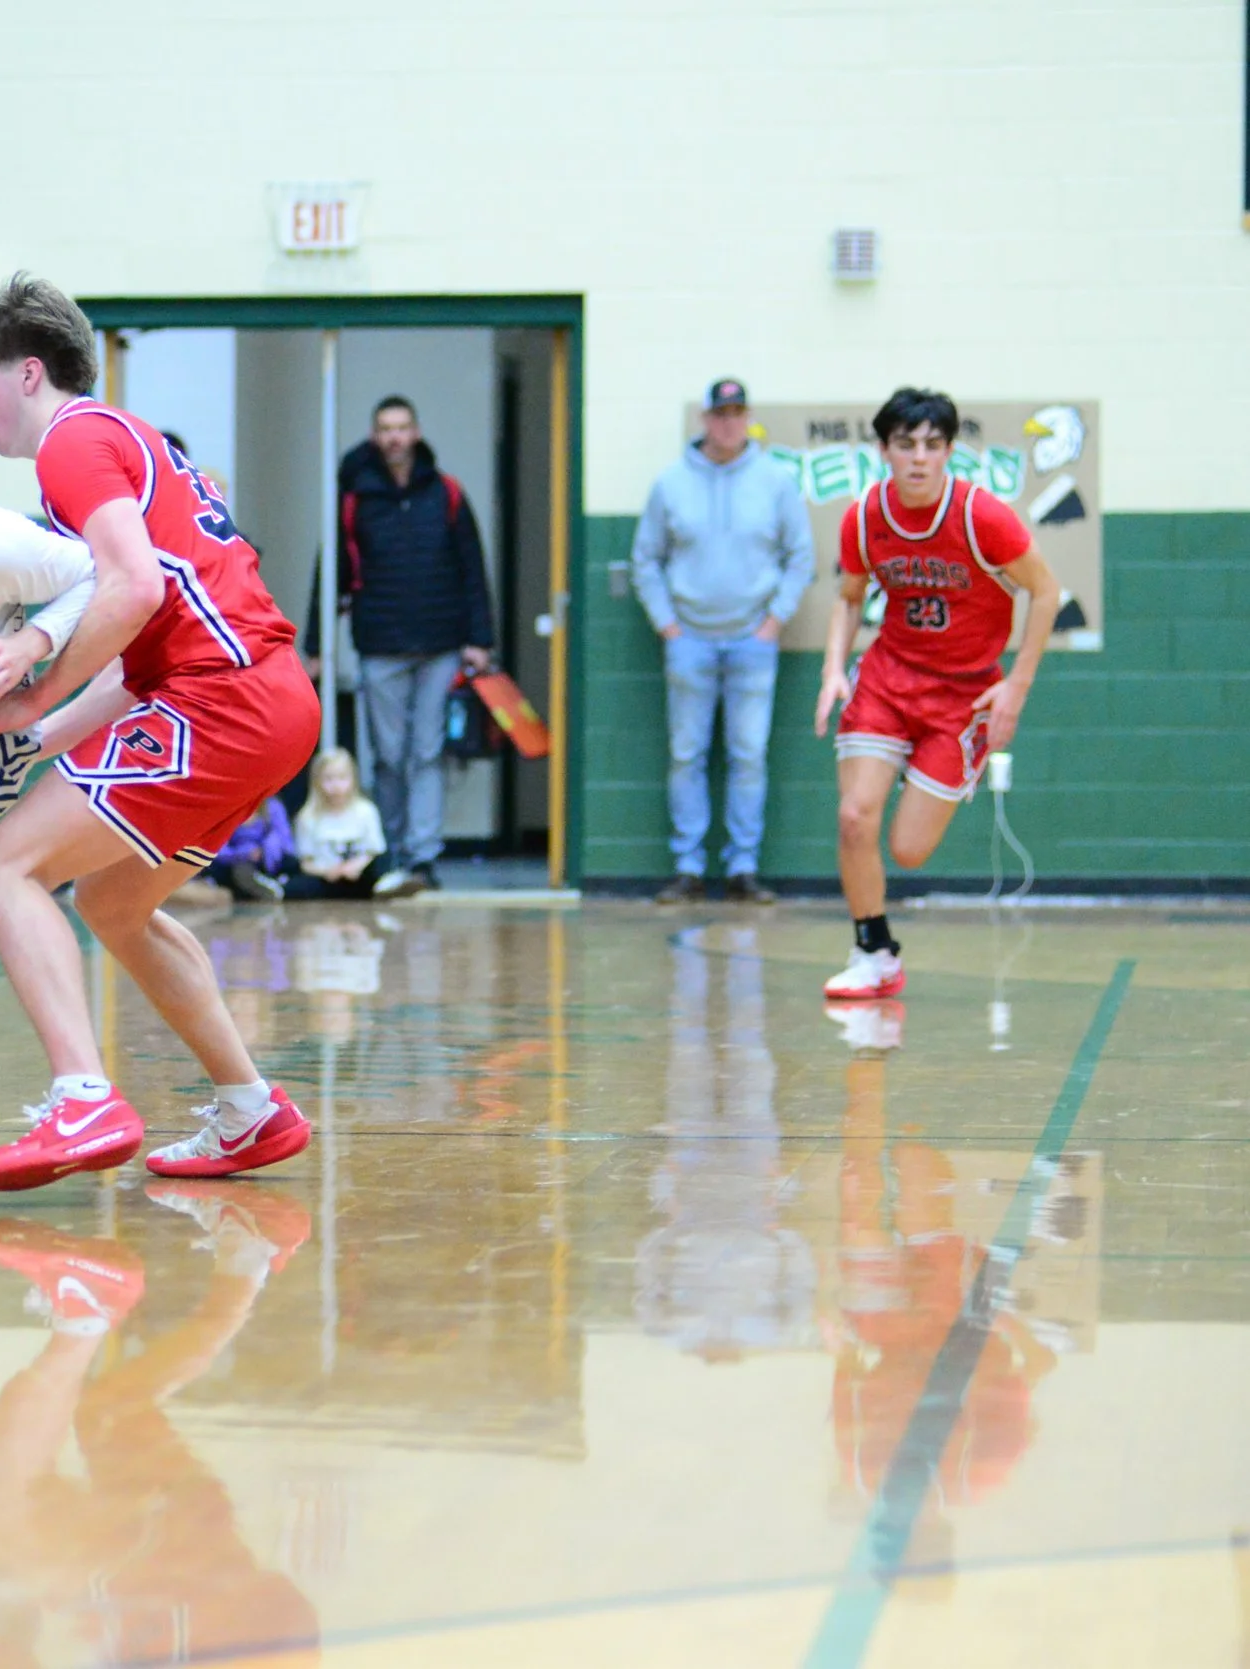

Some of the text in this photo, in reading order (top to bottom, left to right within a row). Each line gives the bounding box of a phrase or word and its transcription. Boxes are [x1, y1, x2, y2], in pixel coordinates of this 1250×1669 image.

[292, 200, 347, 243] EXIT
[906, 596, 950, 631] 23
[119, 727, 164, 756] P
